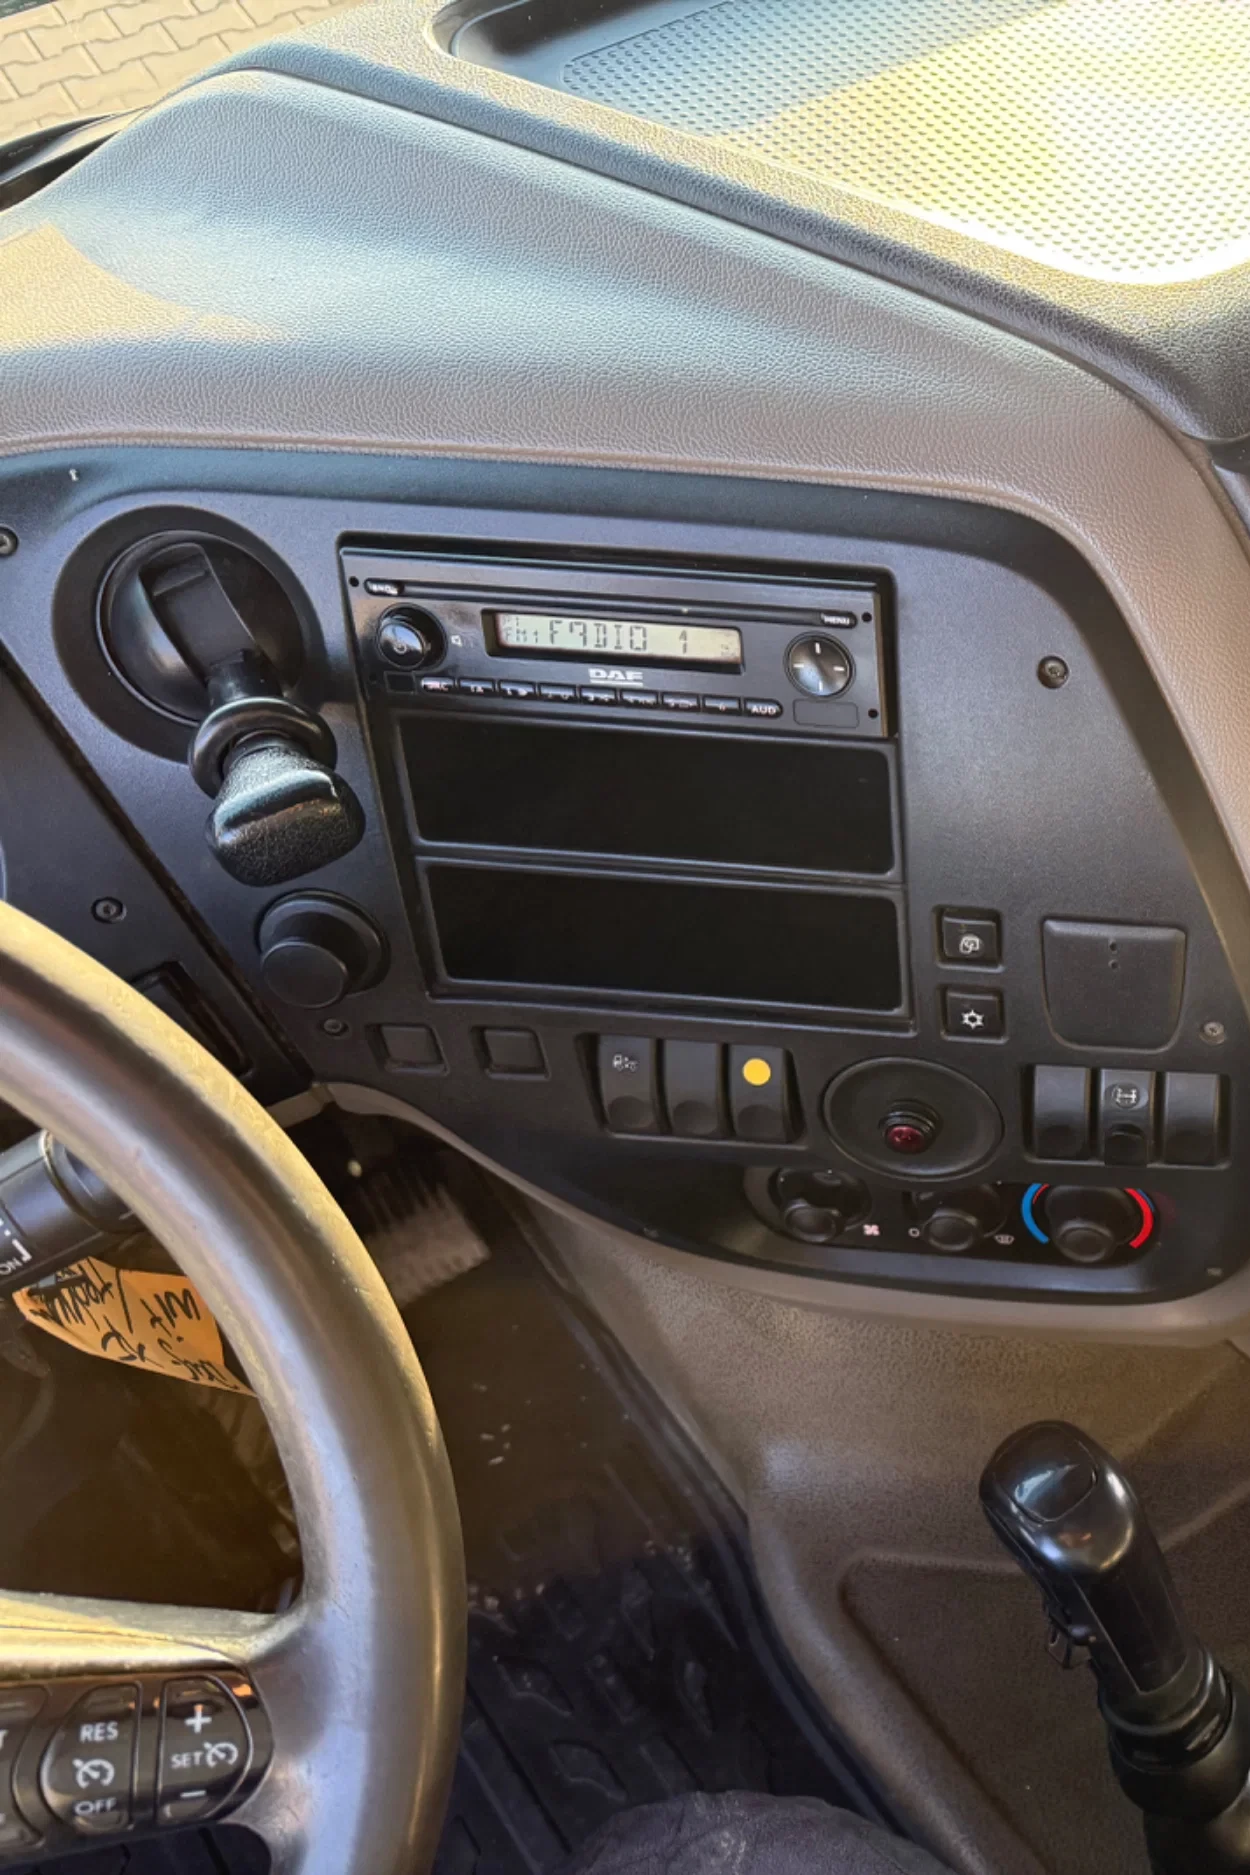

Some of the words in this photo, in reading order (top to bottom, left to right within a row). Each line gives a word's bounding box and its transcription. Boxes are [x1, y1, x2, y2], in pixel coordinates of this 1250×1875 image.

[823, 615, 850, 625] MENU
[588, 668, 643, 684] DAF
[750, 705, 777, 715] AUD
[79, 1721, 119, 1744] RES
[170, 1751, 204, 1769] SET
[74, 1797, 116, 1816] OFF
